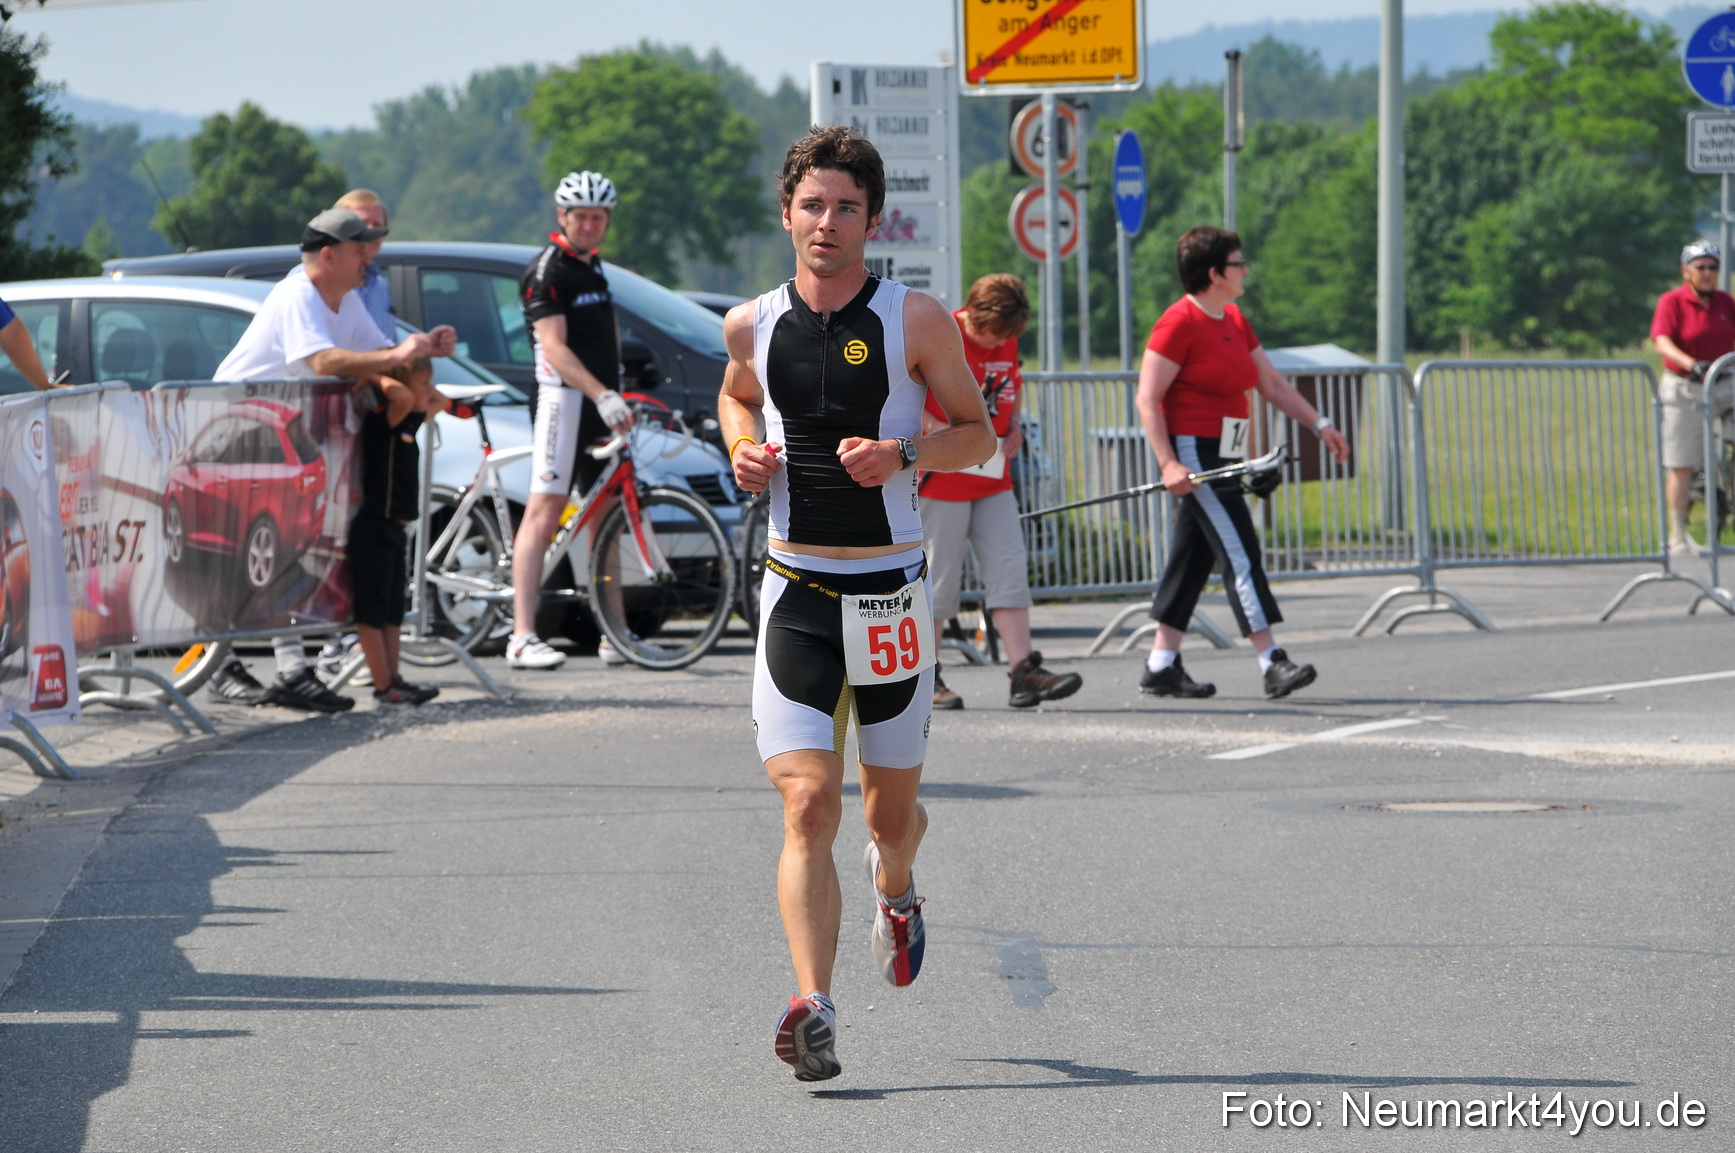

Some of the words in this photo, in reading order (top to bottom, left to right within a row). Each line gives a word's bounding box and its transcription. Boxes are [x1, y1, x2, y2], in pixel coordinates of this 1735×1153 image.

[998, 17, 1029, 33] am
[1040, 13, 1101, 36] Anger
[1015, 50, 1077, 67] Neumarkt
[769, 561, 800, 582] triathlon
[858, 596, 901, 611] MEYER
[858, 607, 902, 619] WERBUNG
[867, 616, 920, 676] 59
